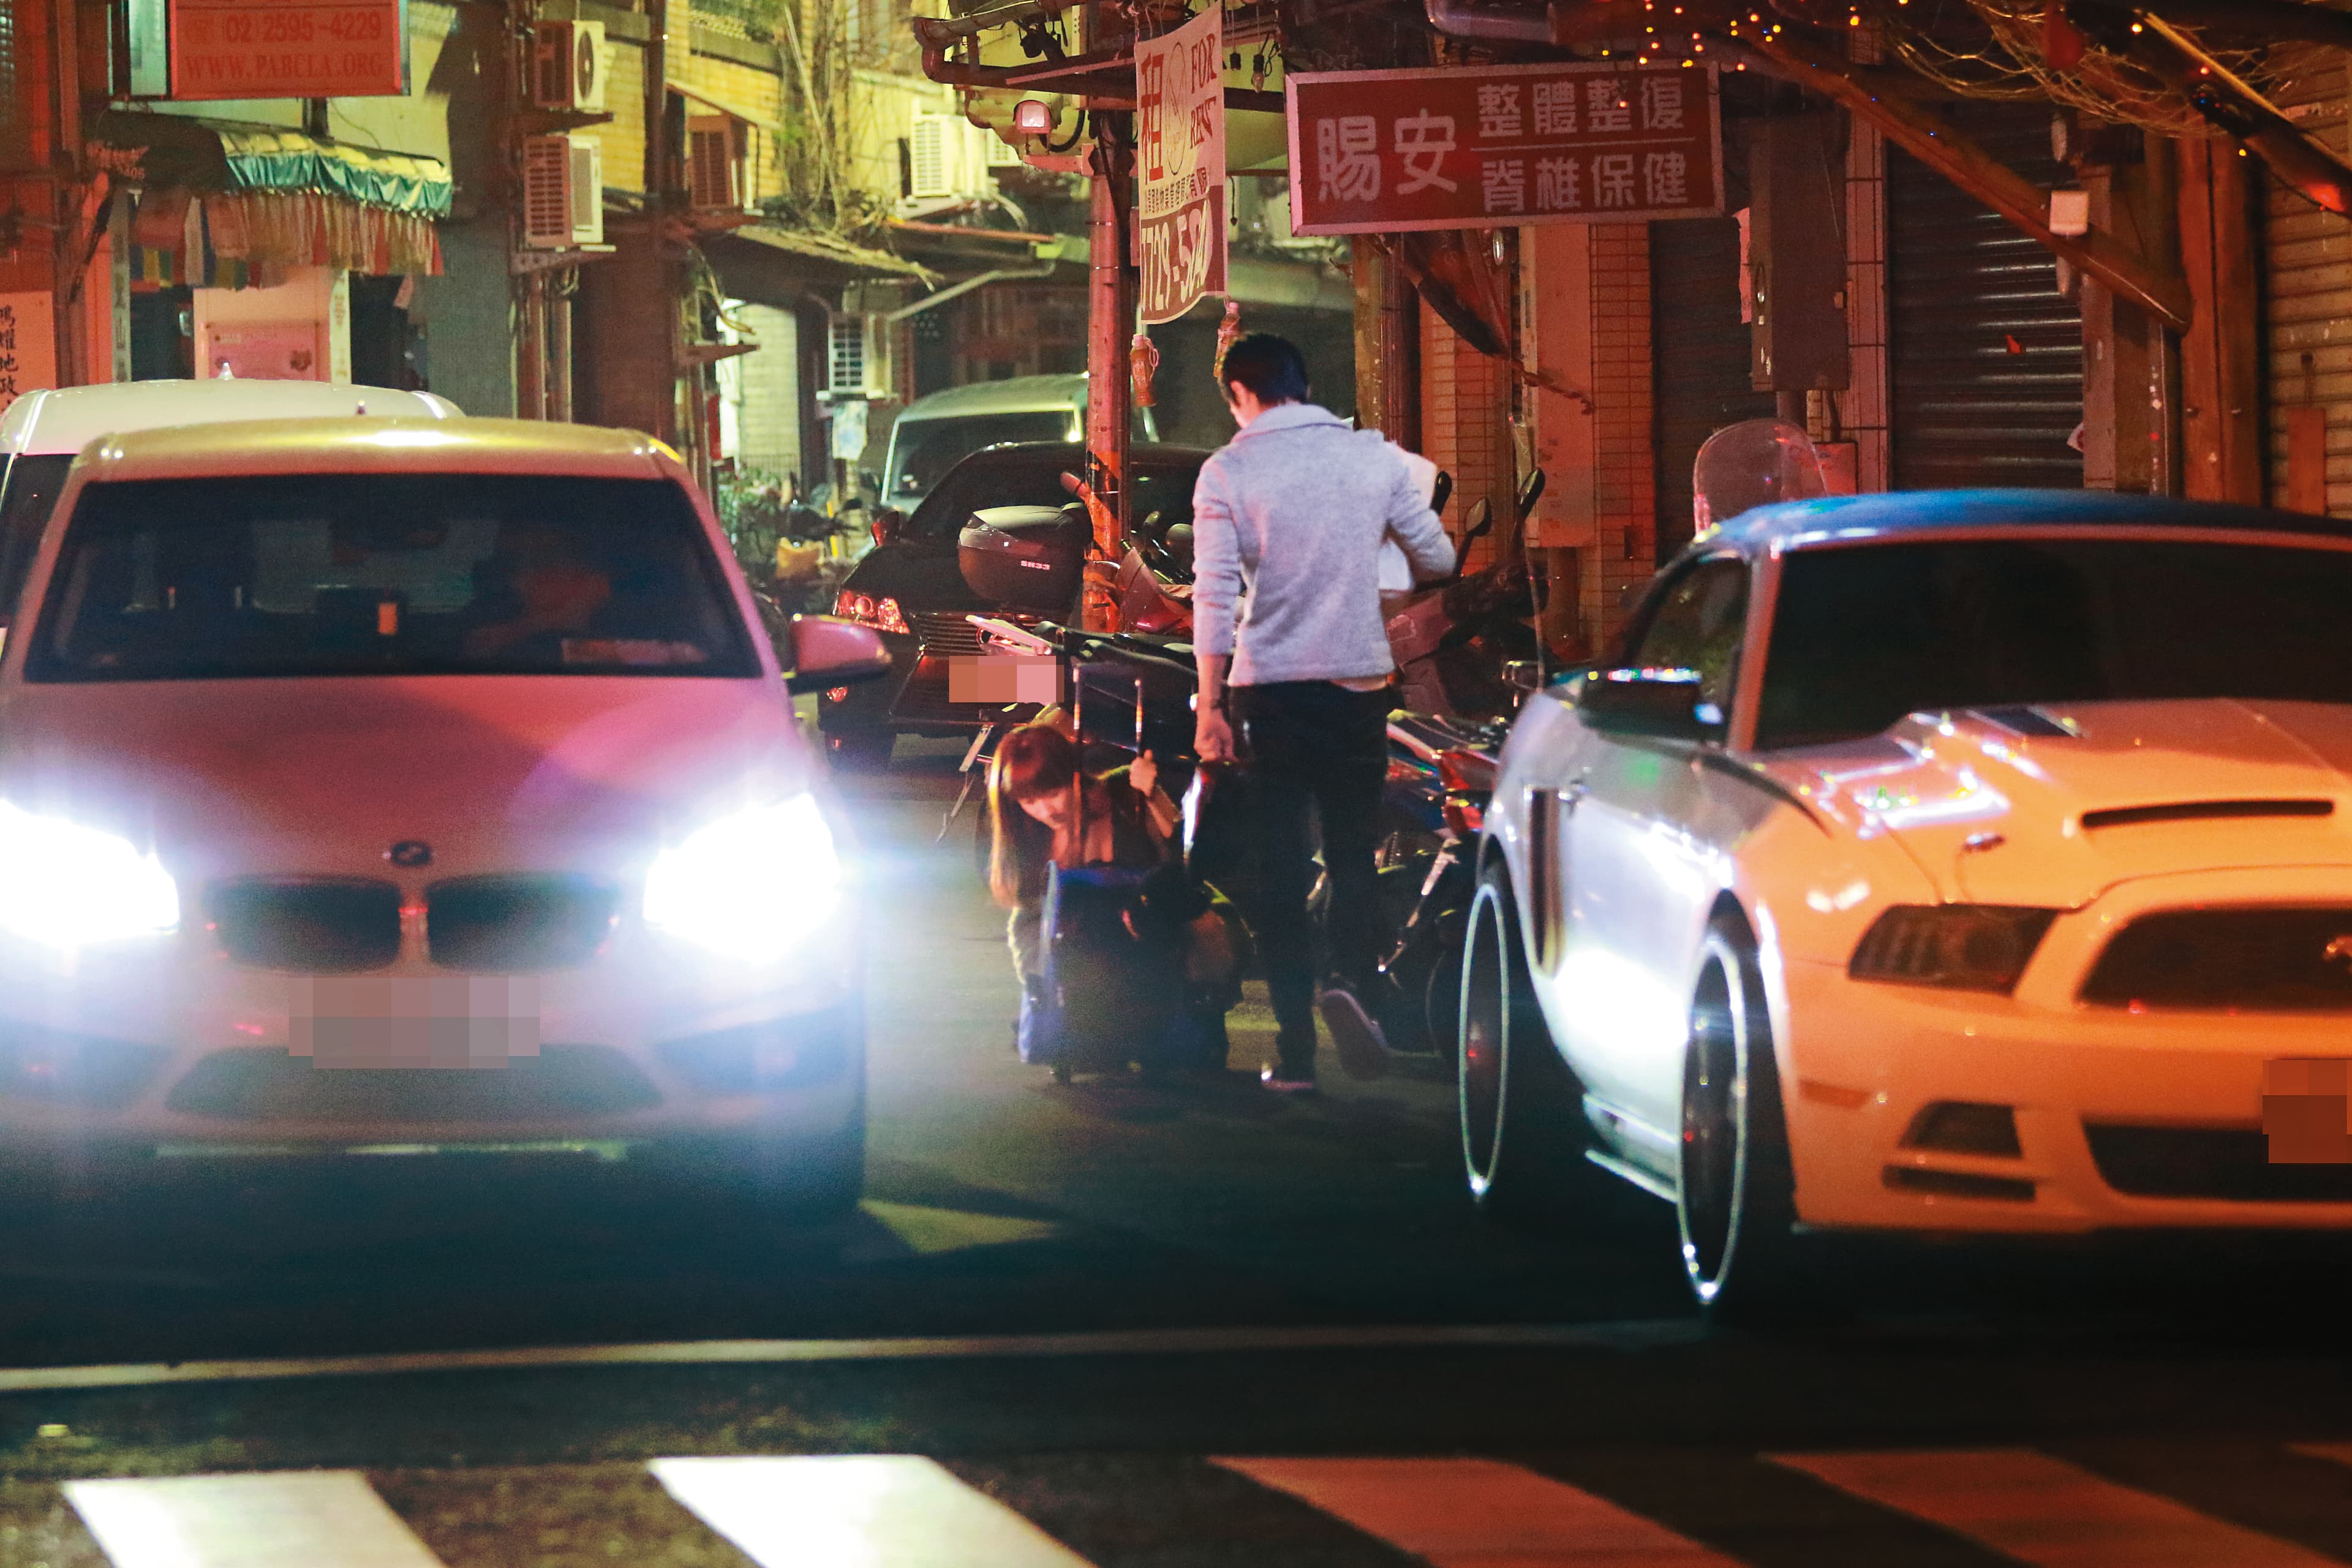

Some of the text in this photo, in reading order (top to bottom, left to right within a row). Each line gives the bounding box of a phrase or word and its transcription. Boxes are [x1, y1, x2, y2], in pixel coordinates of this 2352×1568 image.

[225, 10, 382, 42] 02 2595-4229
[1190, 33, 1217, 94] FOR
[1141, 51, 1164, 185] 租
[1477, 77, 1684, 138] 整體整復
[1315, 107, 1458, 203] 賜安
[1480, 149, 1689, 213] 脊椎保健
